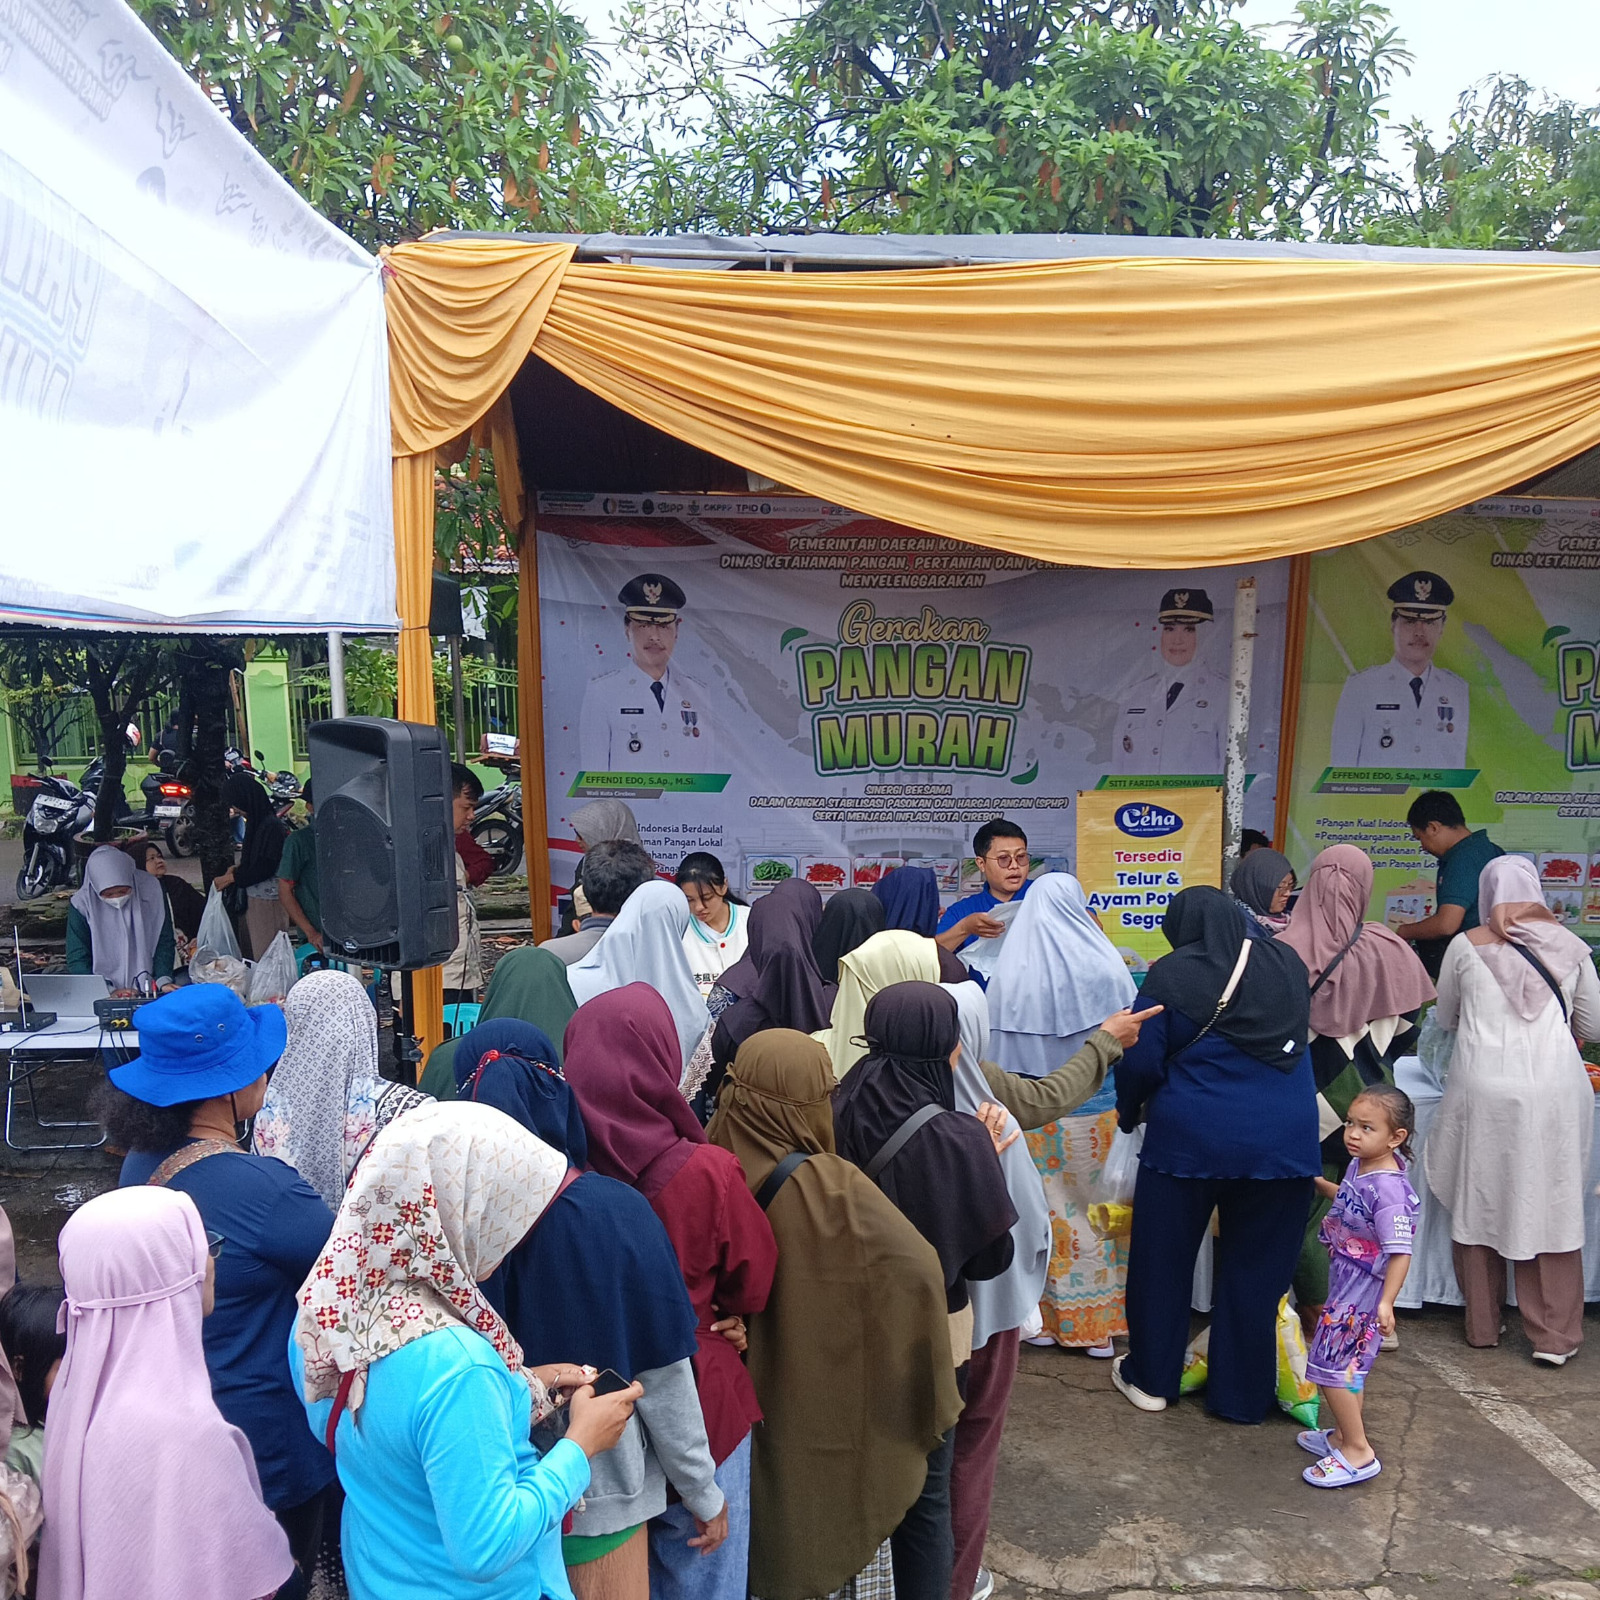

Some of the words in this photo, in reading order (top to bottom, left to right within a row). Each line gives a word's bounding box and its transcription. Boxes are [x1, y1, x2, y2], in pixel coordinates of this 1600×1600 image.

[736, 504, 758, 513] TPID
[789, 537, 879, 551] PEMERINTAH
[880, 537, 939, 551] DAERAH
[720, 554, 762, 568] DINAS
[765, 555, 847, 570] KETAHANAN
[849, 556, 909, 571] PANGAN,
[914, 556, 992, 570] PERTANIAN
[994, 557, 1024, 570] DAN
[1492, 552, 1533, 568] DINAS
[840, 573, 985, 588] MENYELENGGARAKAN
[841, 600, 990, 646] Gerakan
[800, 643, 1028, 707] PANGAN
[816, 711, 1013, 773] MURAH
[585, 776, 622, 784] EFFENDI
[625, 777, 646, 785] EDO,
[1332, 772, 1370, 780] EFFENDI
[1372, 772, 1393, 780] EDO,
[865, 784, 902, 796] SINERGI
[904, 784, 952, 796] BERSAMA
[750, 796, 785, 808] DALAM
[786, 796, 826, 808] RANGKA
[827, 797, 885, 809] STABILISASI
[886, 797, 932, 809] PASOKAN
[934, 797, 956, 809] DAN
[957, 798, 991, 809] HARGA
[992, 798, 1034, 809] PANGAN
[1035, 797, 1069, 809] (SPHP)
[1495, 792, 1532, 803] DALAM
[1532, 792, 1572, 804] RANGKA
[813, 810, 845, 822] SERTA
[846, 811, 894, 822] MENJAGA
[895, 811, 931, 822] INFLASI
[932, 811, 960, 822] KOTA
[1558, 806, 1589, 817] SERTA
[1122, 808, 1176, 828] Ceha
[638, 823, 679, 833] Indonesia
[664, 837, 696, 849] Pangan
[698, 838, 723, 847] Lokal
[1115, 851, 1182, 863] Tersedia
[1390, 859, 1421, 871] Pangan
[1117, 872, 1162, 886] Telur
[1166, 873, 1180, 885] &
[1089, 893, 1141, 909] Ayam
